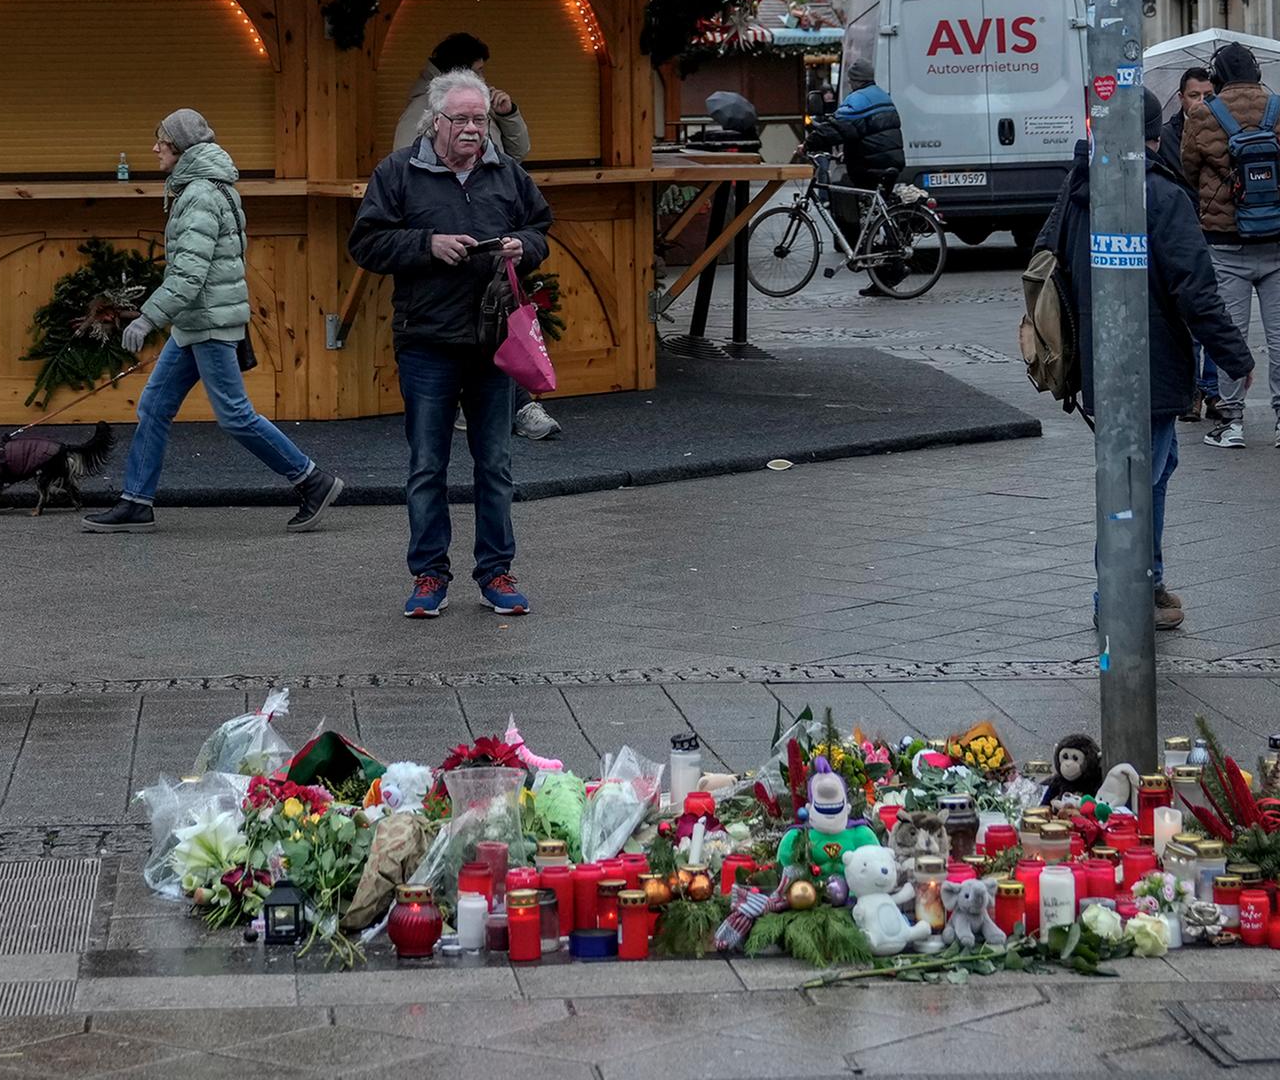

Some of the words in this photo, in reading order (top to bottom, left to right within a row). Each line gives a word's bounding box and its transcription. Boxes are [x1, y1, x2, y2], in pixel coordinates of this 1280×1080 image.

[926, 16, 1038, 57] AVIS
[926, 61, 1040, 75] Autovermietung
[908, 140, 942, 149] IVECO
[1043, 137, 1069, 145] DAILY
[930, 174, 942, 186] EU
[948, 173, 961, 185] LK
[962, 173, 985, 184] 9597
